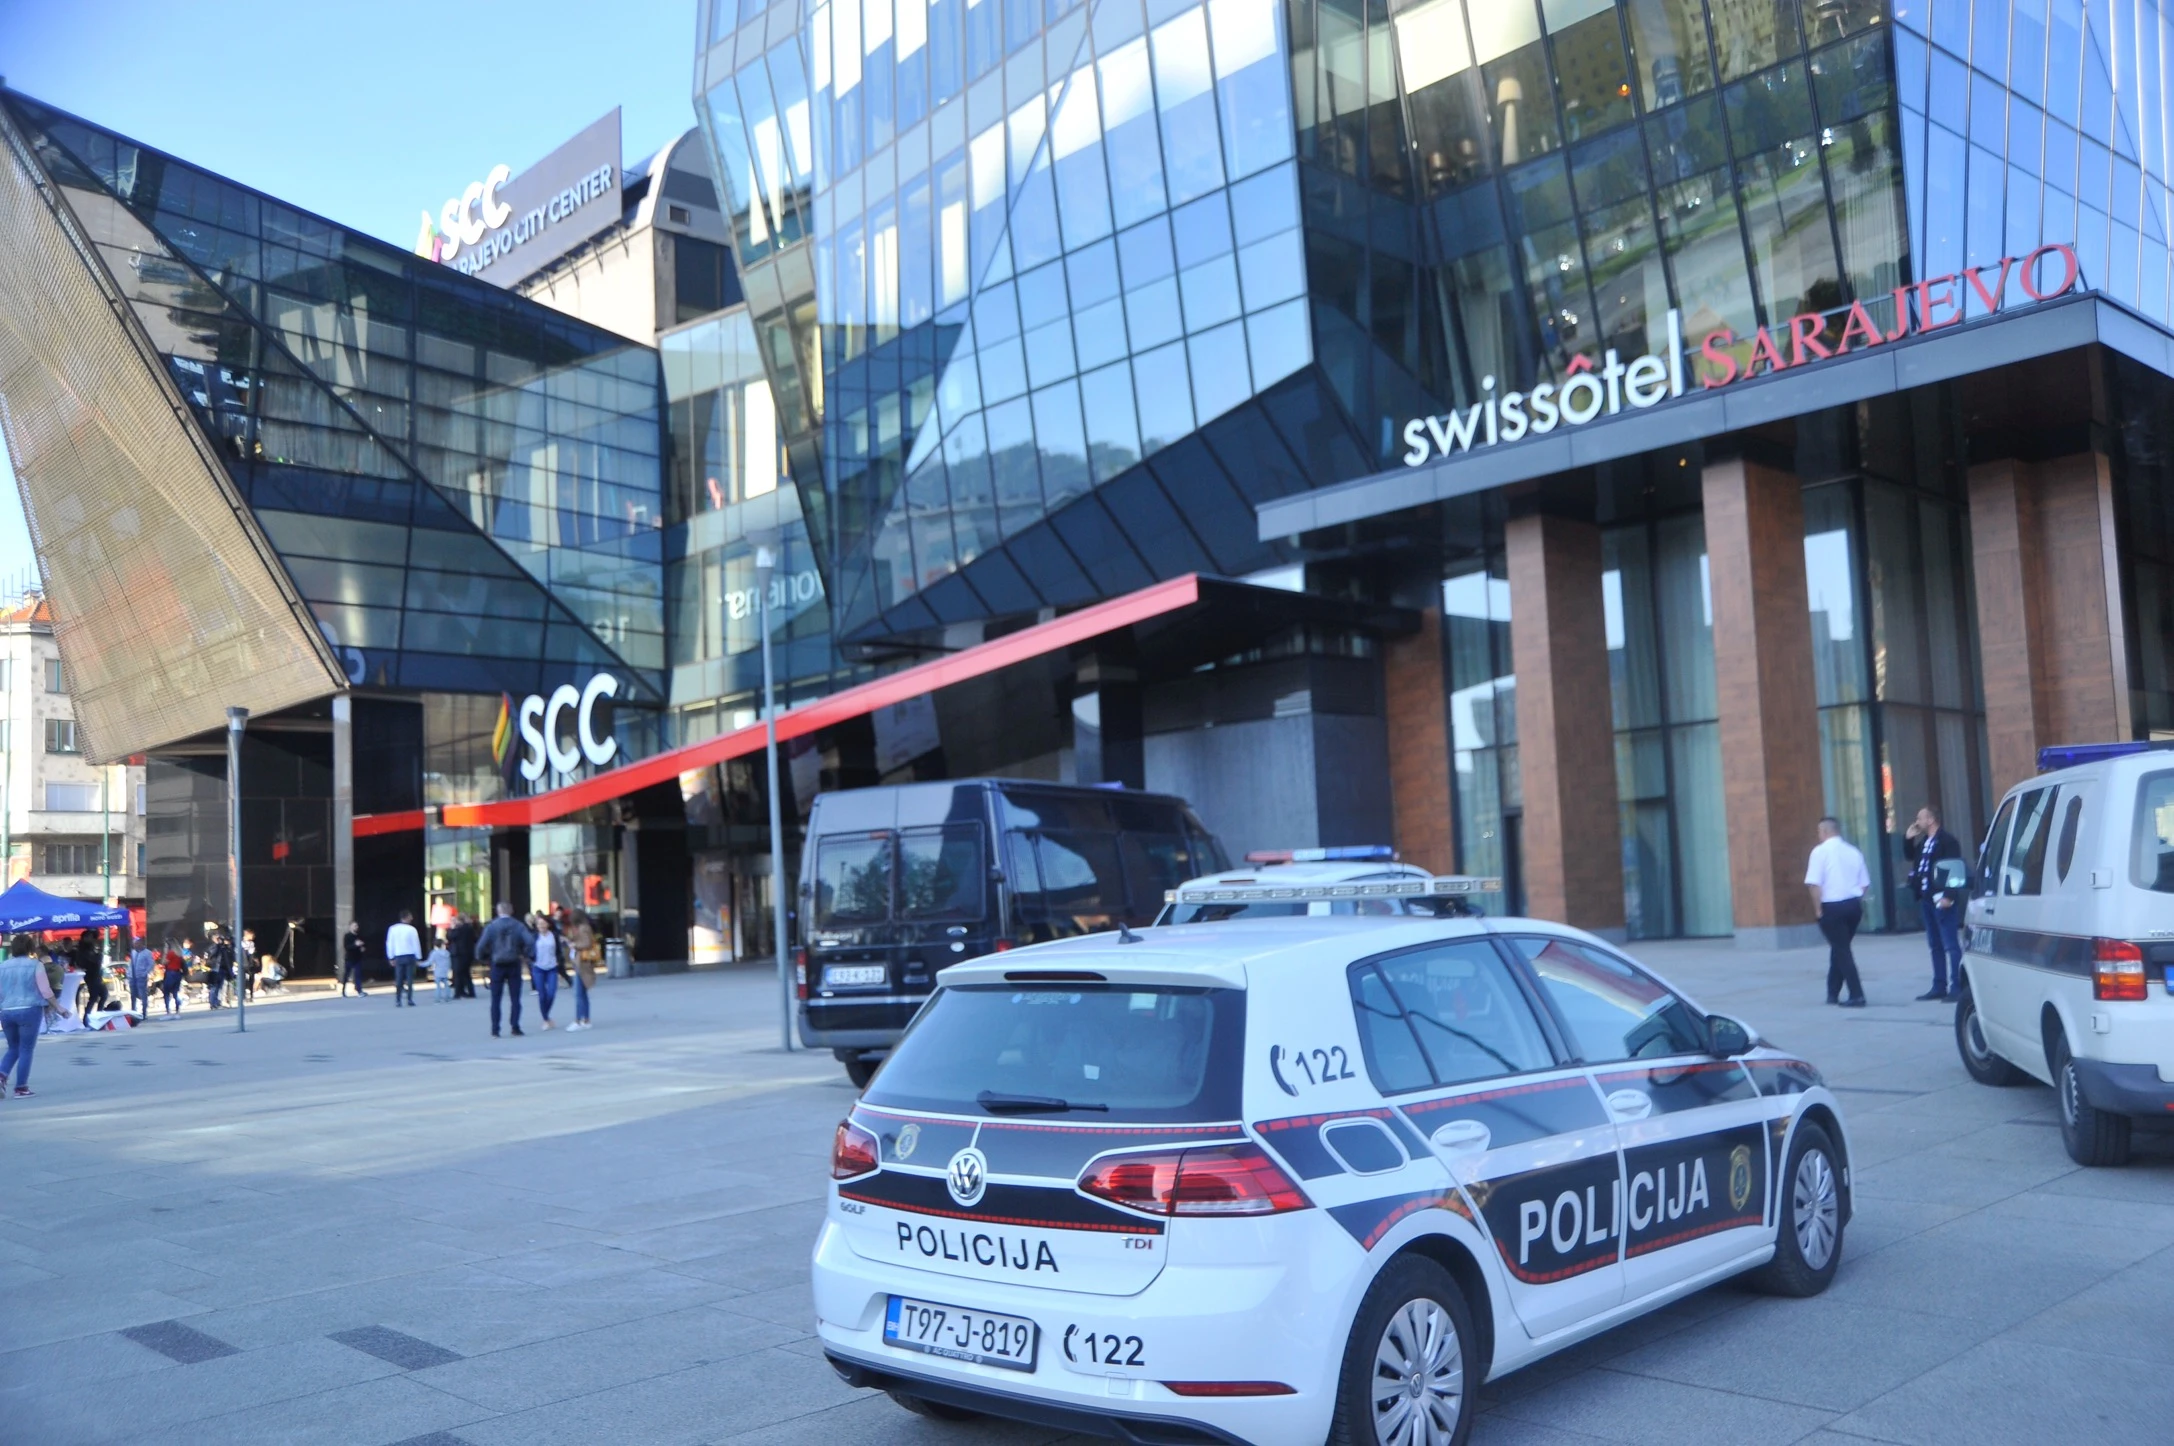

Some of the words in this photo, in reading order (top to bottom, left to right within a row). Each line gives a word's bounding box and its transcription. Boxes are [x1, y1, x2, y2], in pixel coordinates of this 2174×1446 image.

[440, 164, 512, 261] SCC
[452, 229, 513, 276] ARAJEVO
[514, 204, 547, 245] CITY
[550, 164, 612, 223] CENTER
[1402, 307, 1684, 468] swissôtel
[1701, 243, 2080, 391] SARAJEVO
[520, 672, 618, 781] SCC
[52, 913, 80, 924] aprilia
[1296, 1046, 1355, 1085] 122
[840, 1201, 866, 1215] GOLF
[1519, 1157, 1709, 1265] POLICIJA
[897, 1221, 1059, 1273] POLICIJA
[1121, 1236, 1152, 1250] TDI
[905, 1304, 1029, 1358] T97-J-819
[1085, 1332, 1145, 1366] 122
